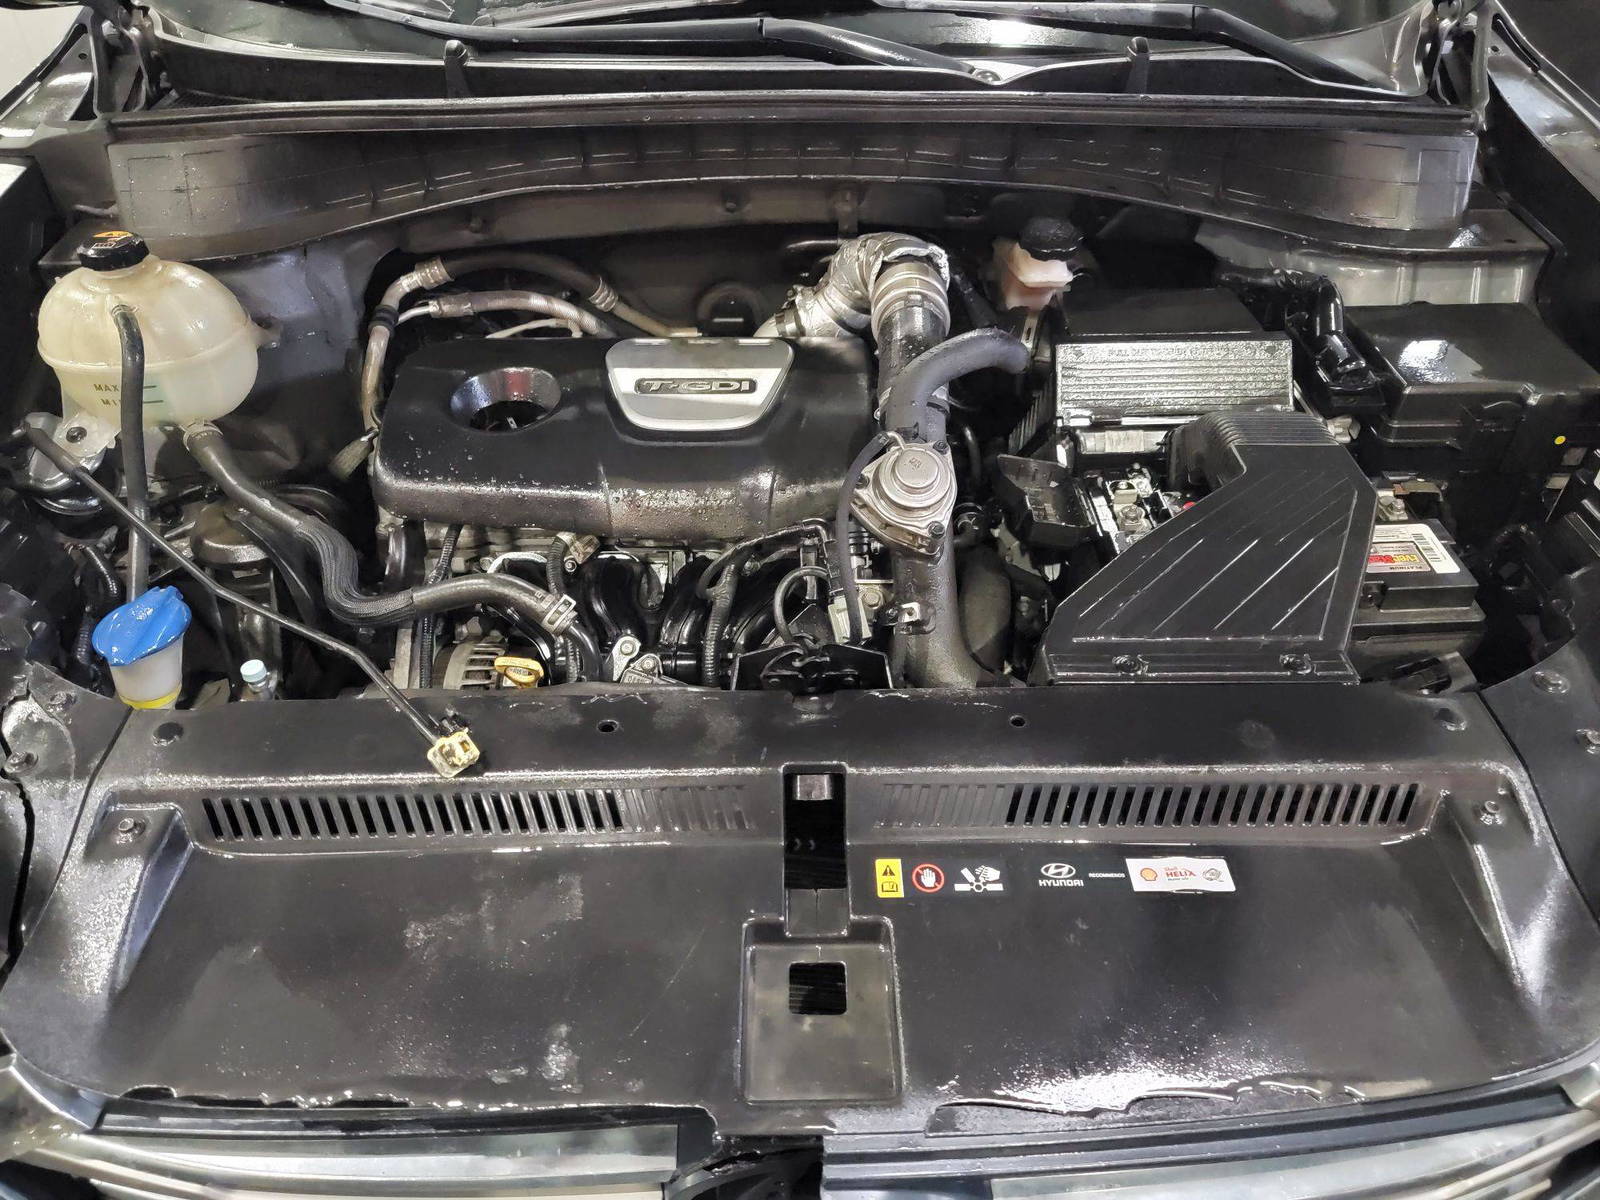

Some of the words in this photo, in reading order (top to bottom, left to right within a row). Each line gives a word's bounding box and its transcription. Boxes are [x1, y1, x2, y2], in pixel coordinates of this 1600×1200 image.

[93, 383, 120, 392] MAX
[100, 398, 122, 406] MI
[1166, 869, 1197, 877] HELIX
[1038, 879, 1085, 887] HYUNDAI
